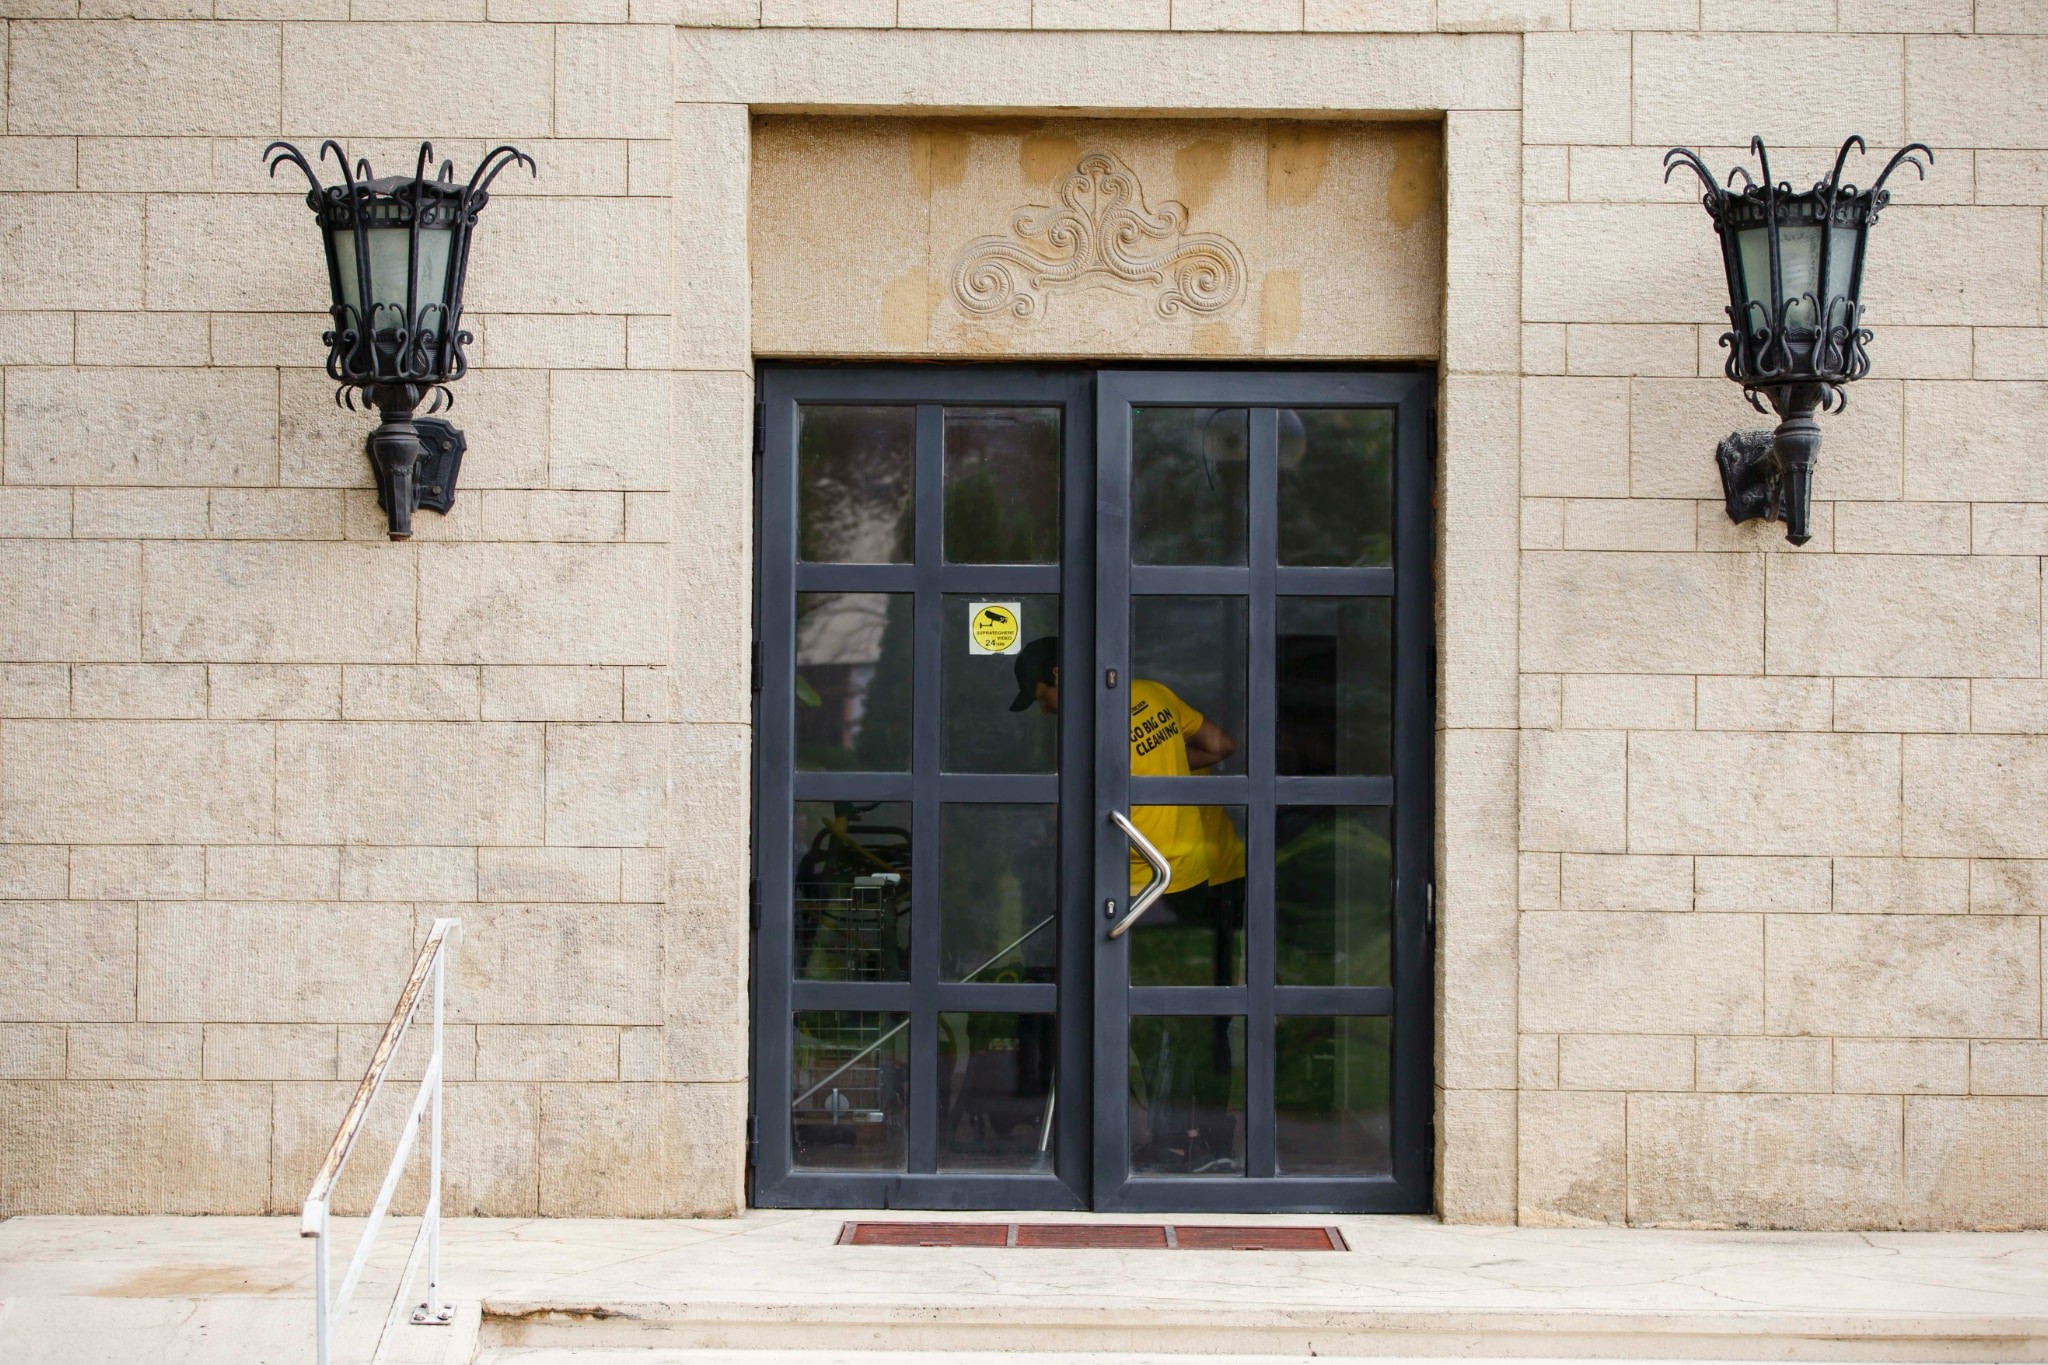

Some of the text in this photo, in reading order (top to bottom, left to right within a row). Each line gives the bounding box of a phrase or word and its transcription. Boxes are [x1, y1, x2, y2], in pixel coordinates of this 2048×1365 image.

[1130, 707, 1174, 743] GO BIG ON
[1136, 721, 1179, 756] CLEANING
